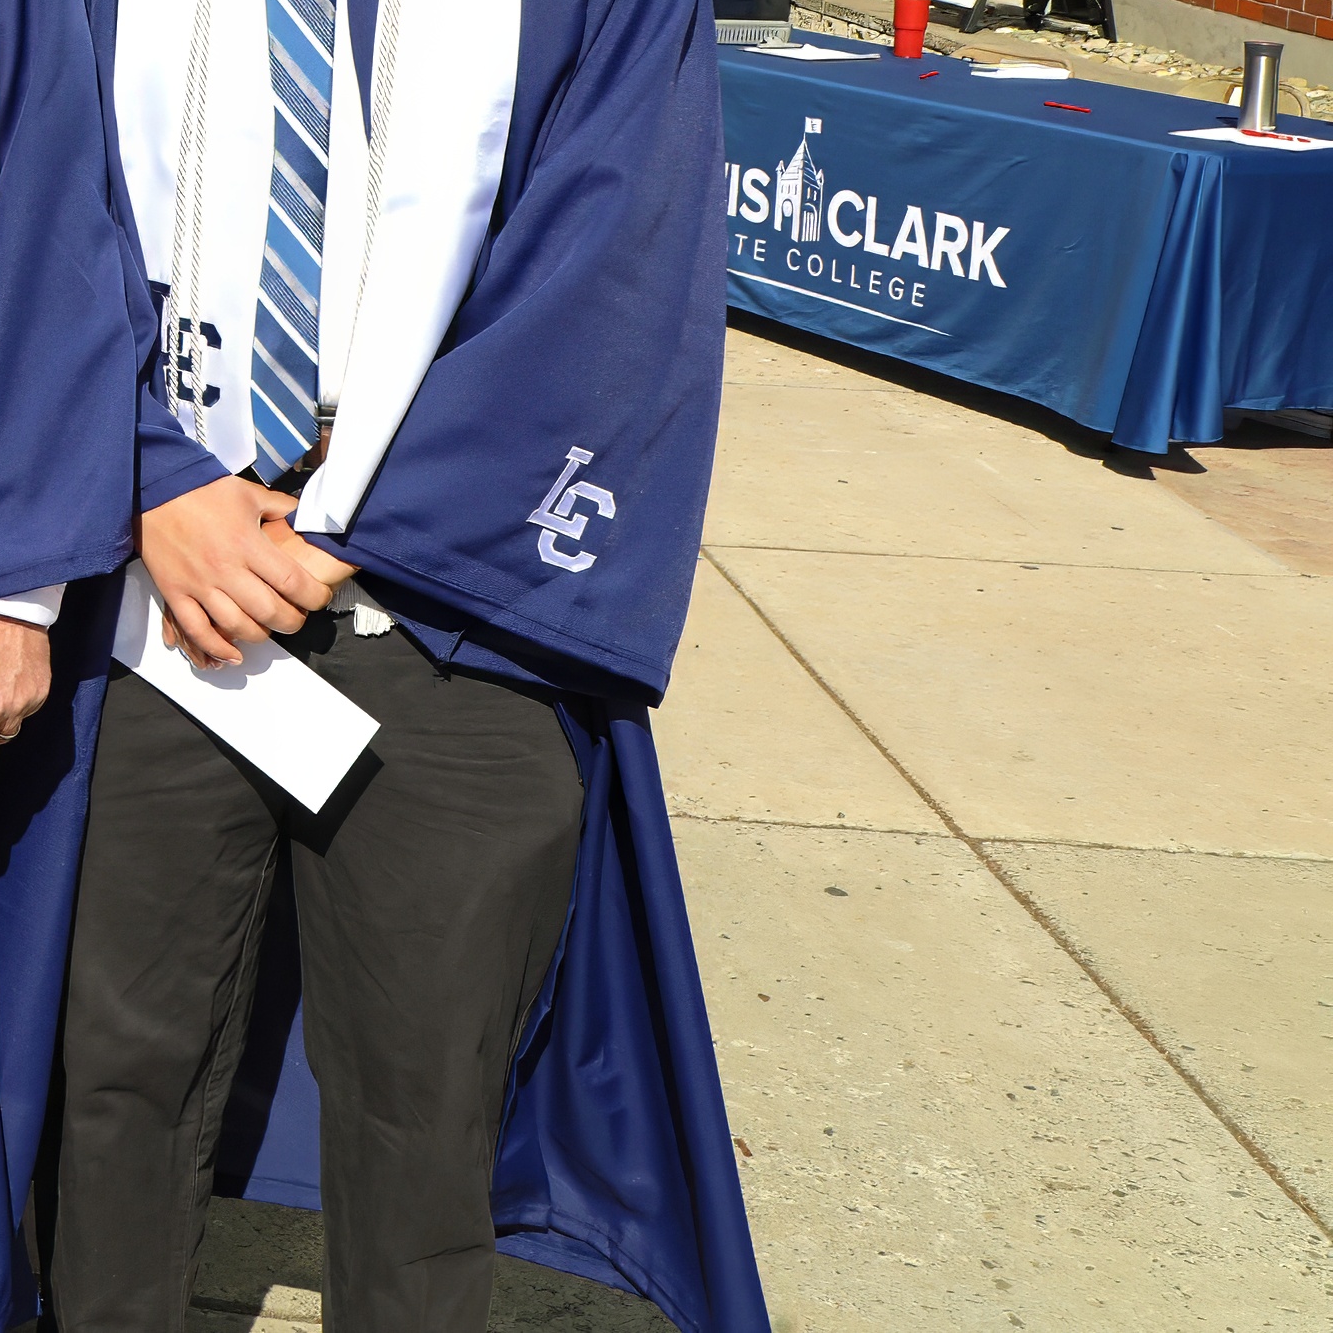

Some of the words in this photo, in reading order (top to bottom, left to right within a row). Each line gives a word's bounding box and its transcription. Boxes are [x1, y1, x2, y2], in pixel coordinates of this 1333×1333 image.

[724, 162, 771, 224] IS
[827, 189, 1011, 289] CLARK
[786, 248, 926, 308] COLLEGE
[525, 446, 617, 573] LC
